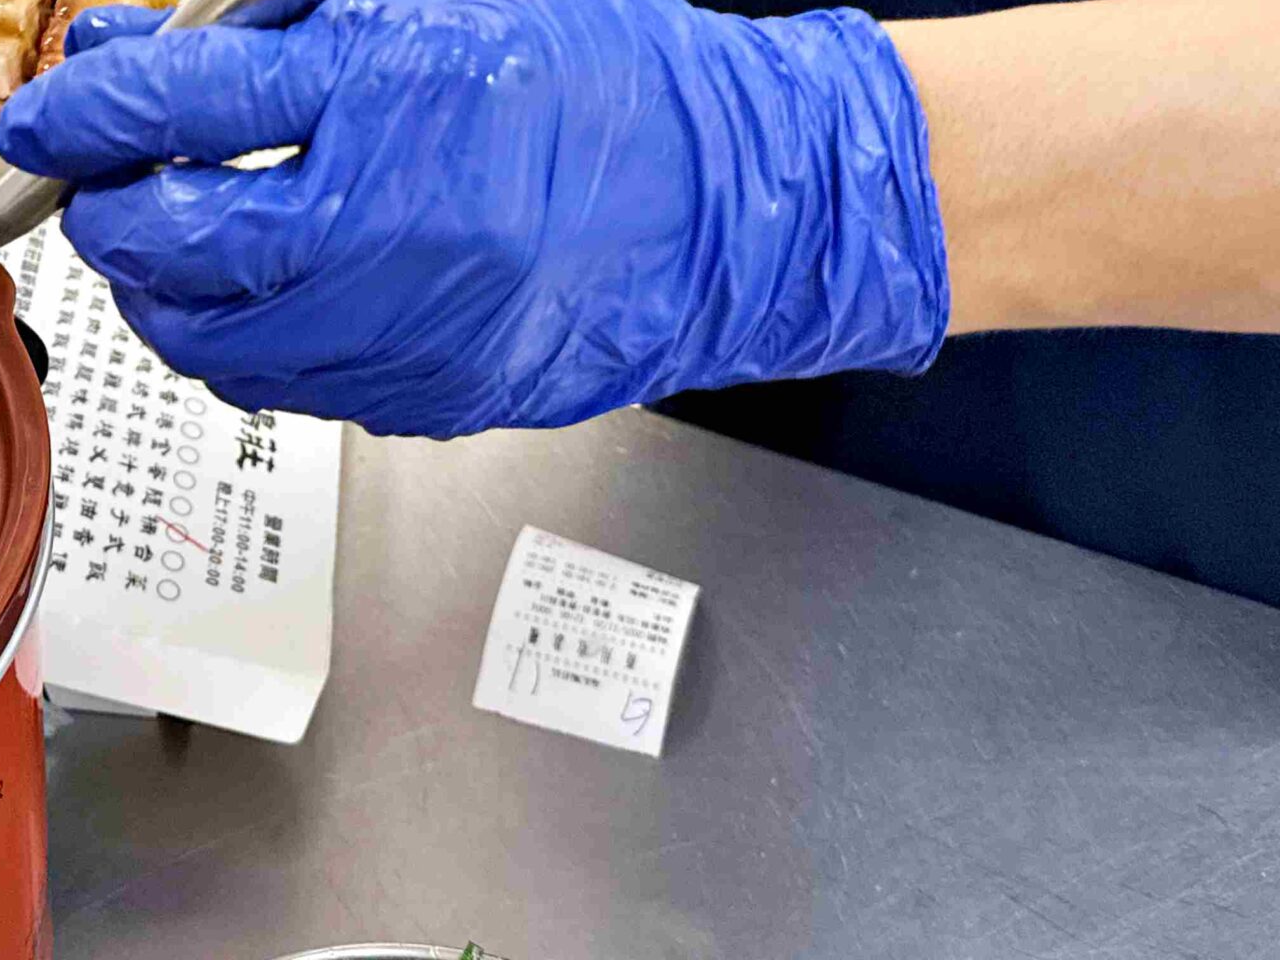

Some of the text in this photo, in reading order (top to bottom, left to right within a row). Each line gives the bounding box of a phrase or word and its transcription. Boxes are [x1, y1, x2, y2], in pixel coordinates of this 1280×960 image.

[231, 489, 257, 593] 中午11:00-14:00
[258, 513, 284, 584] 營業時間
